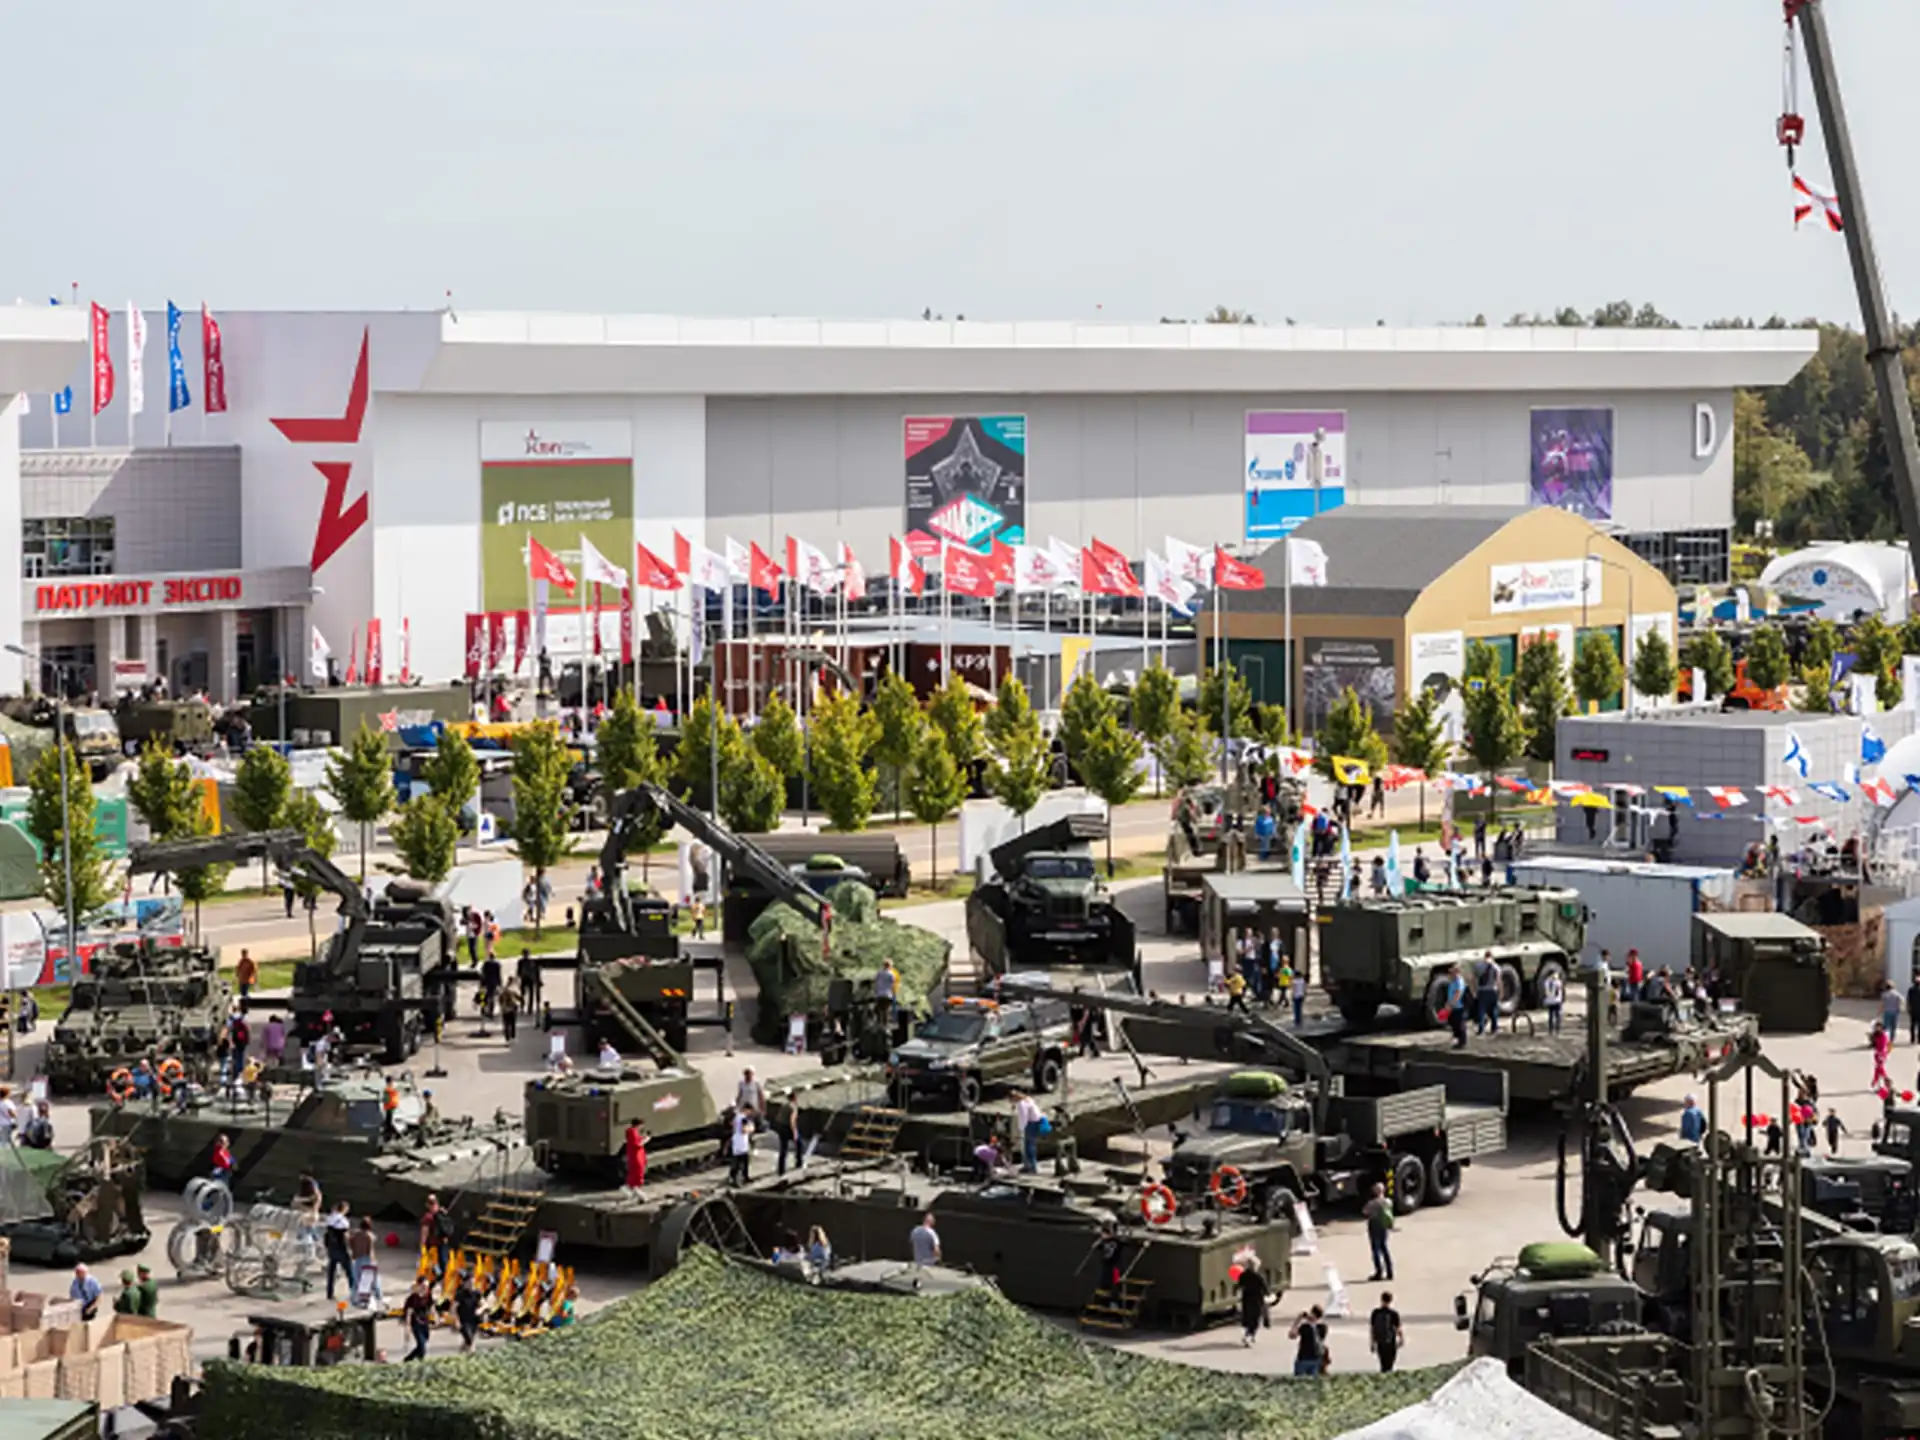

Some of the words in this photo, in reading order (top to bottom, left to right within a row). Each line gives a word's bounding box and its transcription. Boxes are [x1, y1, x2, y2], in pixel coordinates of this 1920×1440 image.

[1693, 402, 1717, 458] D
[36, 581, 153, 609] ПАТРИОТ
[163, 576, 242, 603] ЭКСПО
